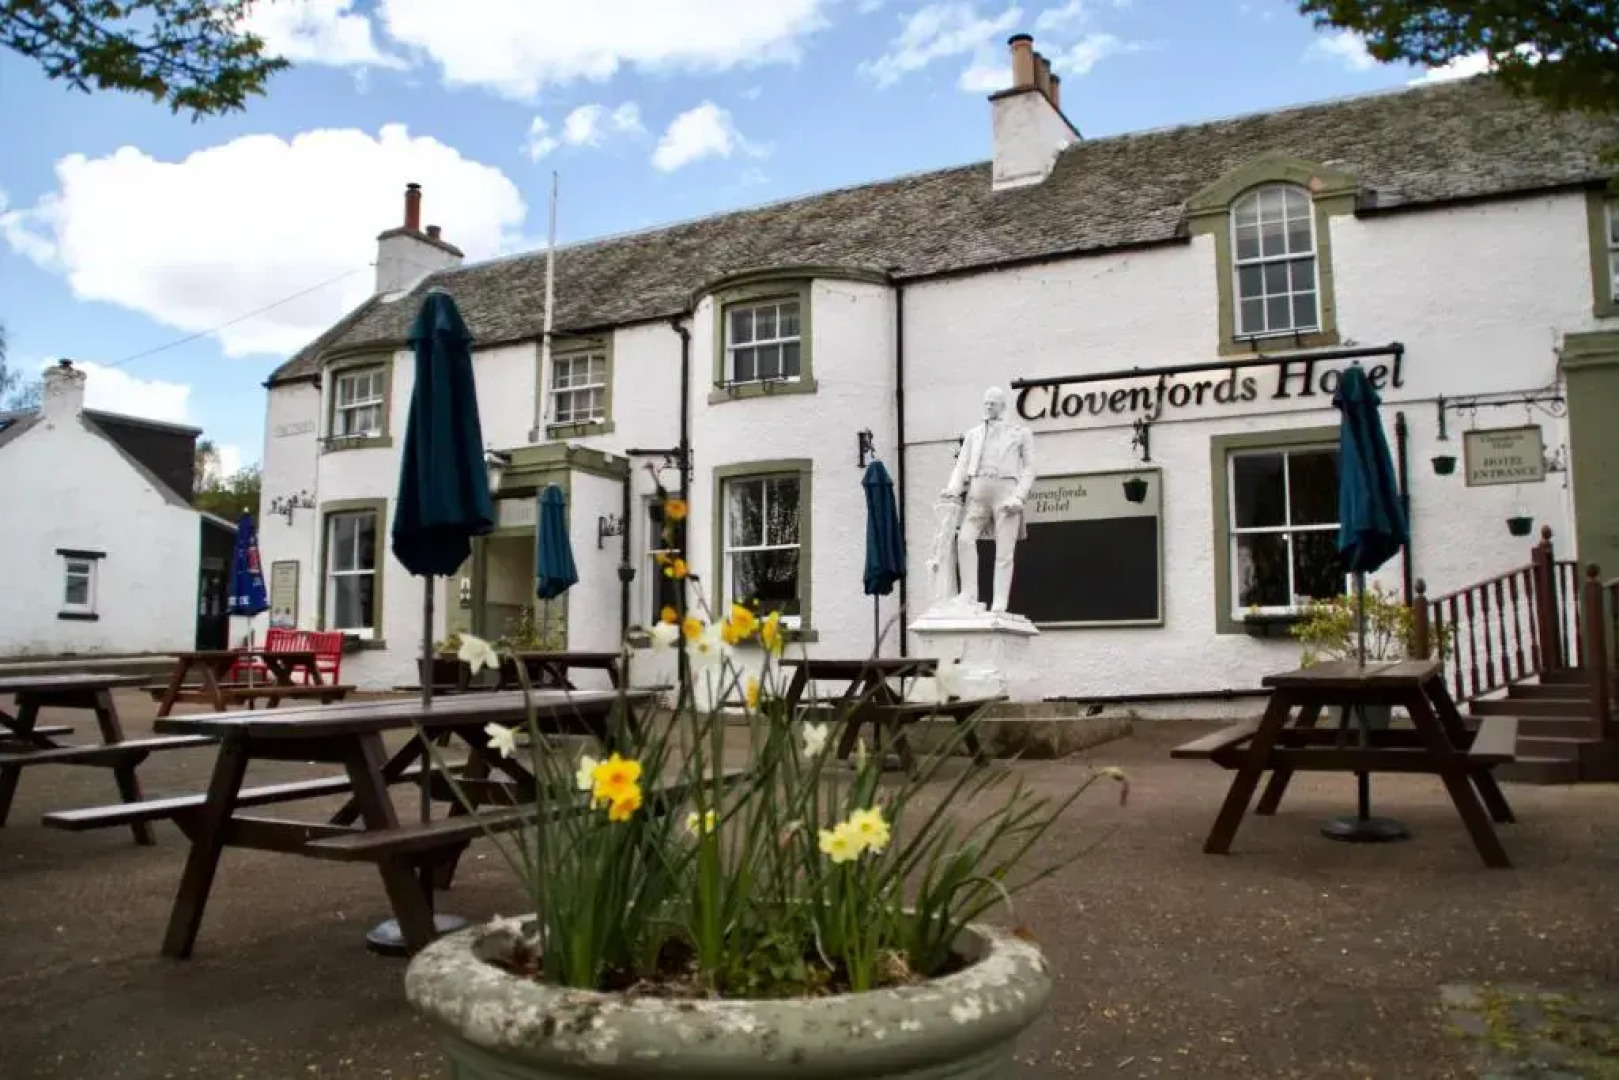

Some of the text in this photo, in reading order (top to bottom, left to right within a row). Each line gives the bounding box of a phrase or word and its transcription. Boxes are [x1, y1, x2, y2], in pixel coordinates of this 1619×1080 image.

[1017, 354, 1404, 421] Clovenfords Hoel
[1483, 457, 1525, 468] HOTEL
[1473, 467, 1538, 481] ENTRANCE
[1027, 484, 1087, 502] lovenfords
[1036, 499, 1070, 512] Hotel
